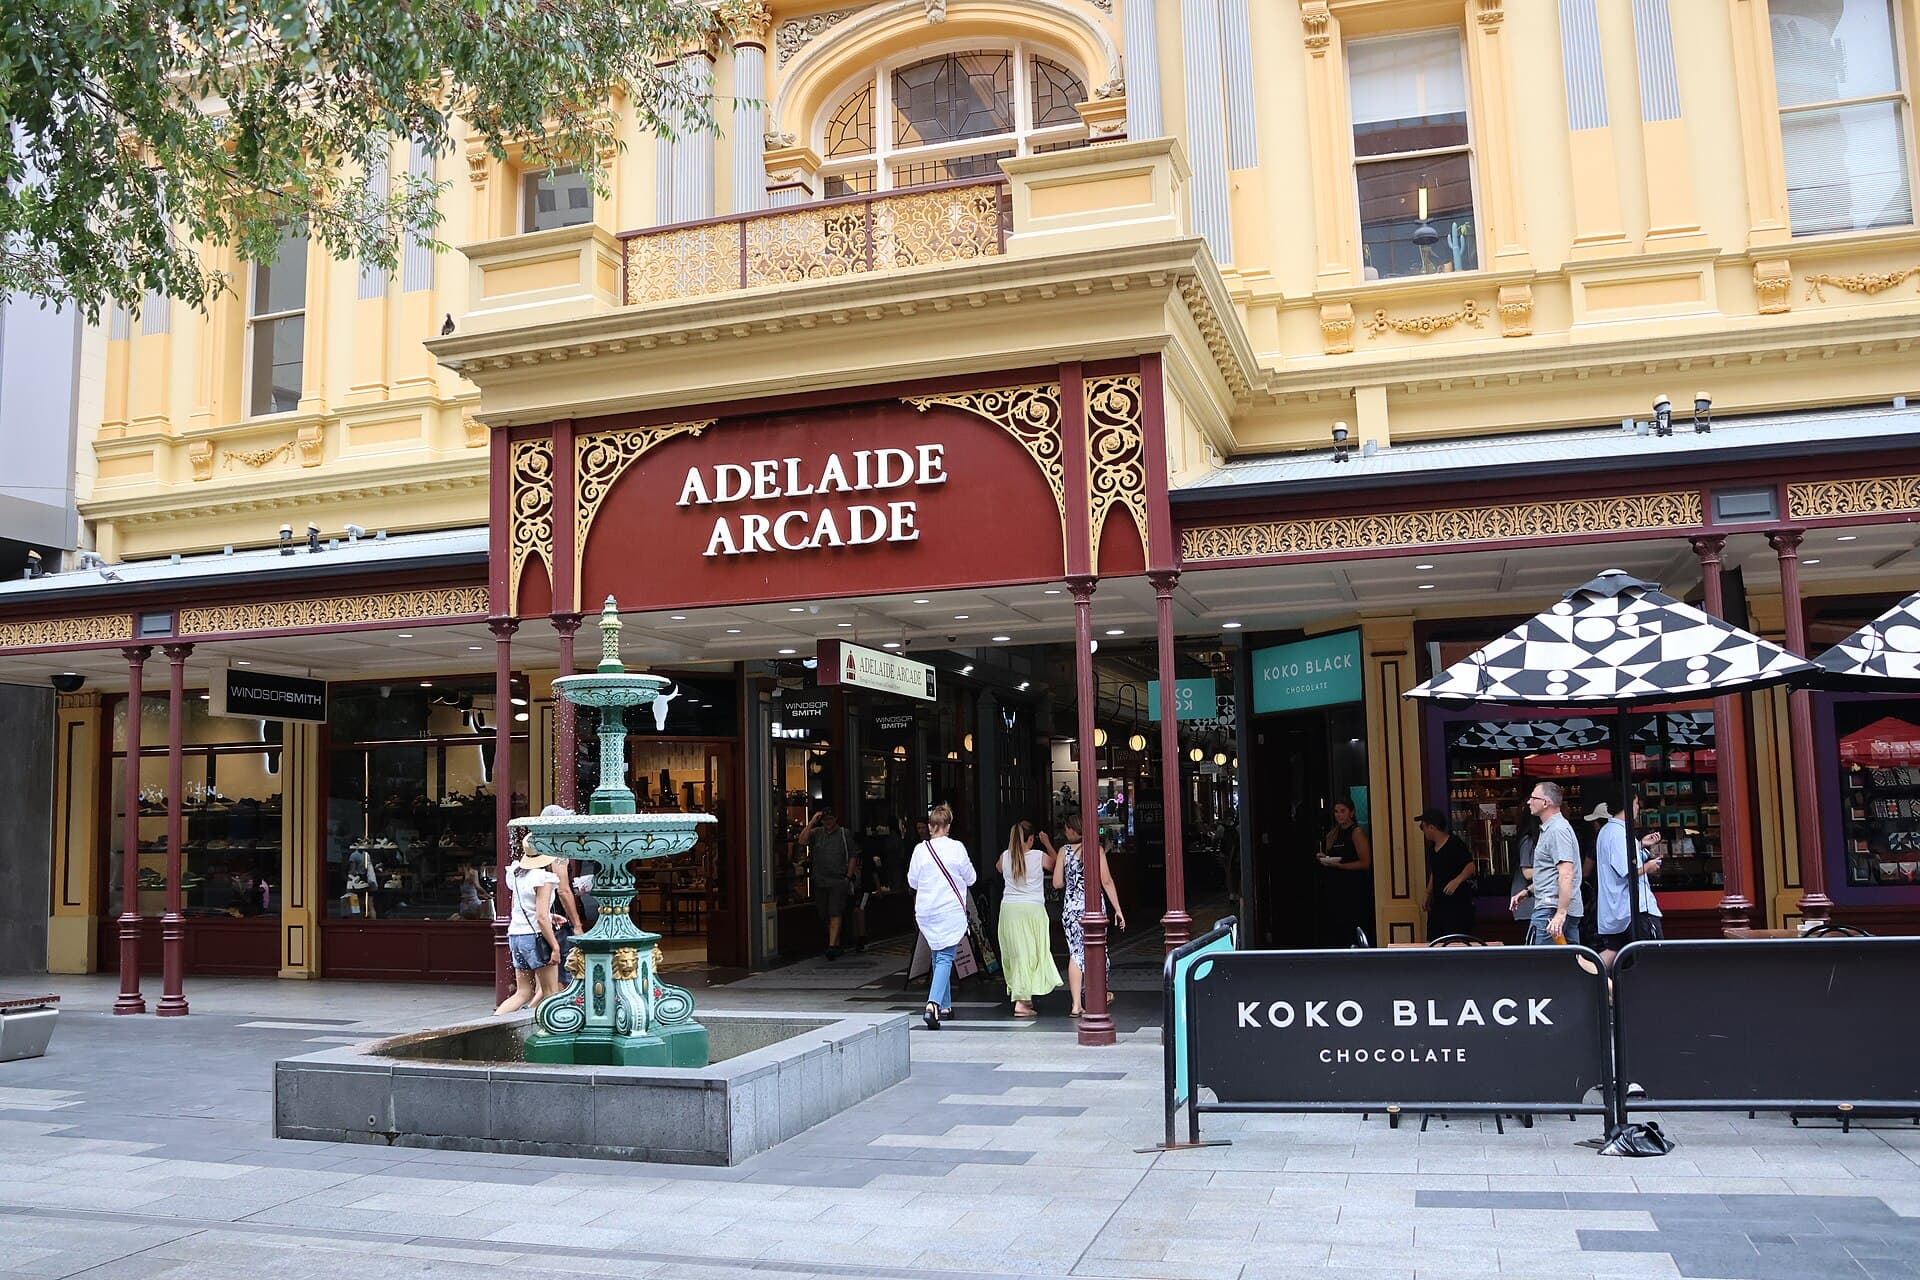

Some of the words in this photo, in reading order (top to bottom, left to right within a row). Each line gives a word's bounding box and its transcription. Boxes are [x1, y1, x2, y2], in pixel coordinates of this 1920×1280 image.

[675, 444, 948, 506] ADELAIDE
[702, 501, 920, 556] ARCADE
[859, 657, 895, 679] ADELAIDE
[896, 666, 922, 685] ARCADE
[1263, 664, 1299, 681] KOKO
[1305, 654, 1353, 674] BLACK
[1286, 681, 1328, 695] CHOCOLATE
[785, 701, 828, 709] WINDSOR
[791, 708, 822, 717] SMITH
[875, 715, 913, 723] WINDSOR
[881, 722, 907, 730] SMITH
[419, 729, 433, 739] 115
[1237, 1000, 1364, 1029] KOKO
[1393, 998, 1555, 1027] BLACK
[1319, 1048, 1467, 1063] CHOCOLATE
